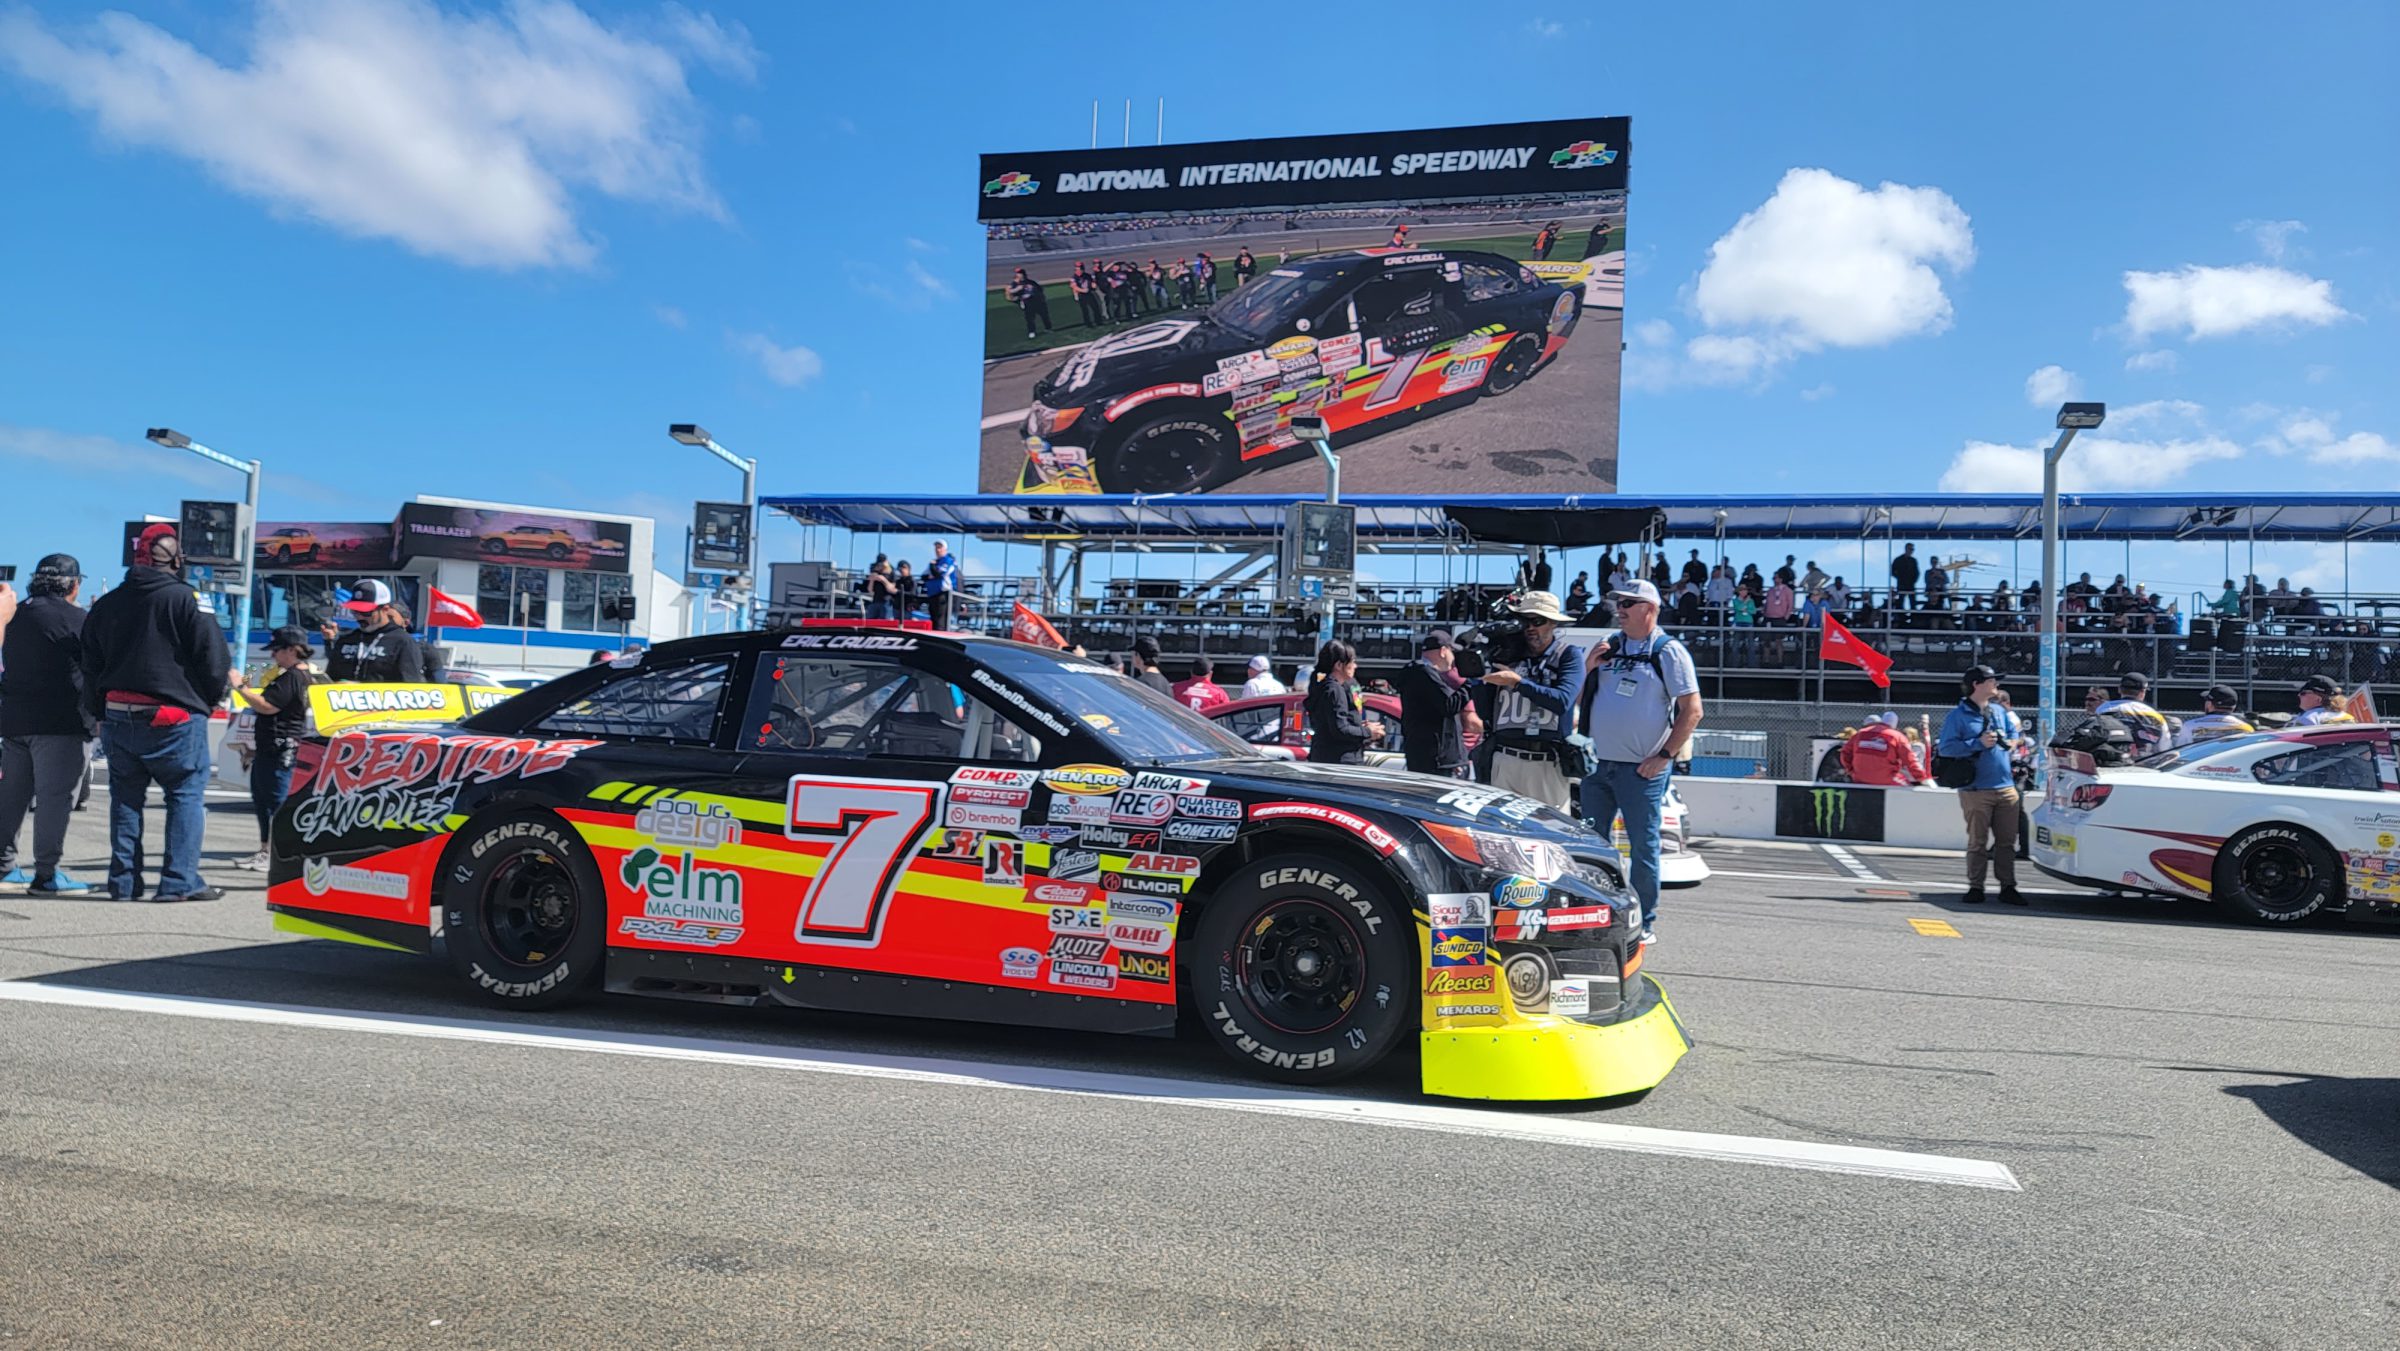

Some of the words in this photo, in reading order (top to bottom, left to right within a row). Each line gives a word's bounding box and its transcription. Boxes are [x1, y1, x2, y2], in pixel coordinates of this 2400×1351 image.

[1056, 168, 1164, 193] DAYTONA
[1179, 156, 1382, 187] INTERNATIONAL
[1391, 147, 1536, 176] SPEEDWAY
[1221, 356, 1249, 370] ARCA
[1451, 356, 1487, 376] elm
[1146, 421, 1223, 442] GENERAL
[410, 523, 472, 538] TRAILBLAZER
[780, 634, 831, 648] ERIC
[827, 635, 919, 650] CAUDELL
[326, 688, 446, 711] MENARDS
[971, 668, 1071, 738] #RachelDawnRuns
[957, 768, 1018, 782] COMP
[1039, 770, 1132, 788] MENARDS
[1136, 774, 1181, 791] ARCA
[956, 787, 1026, 801] PYROTECT
[1177, 796, 1239, 809] QUARTER
[656, 800, 731, 819] DOUG
[969, 811, 1017, 826] brembo
[1186, 805, 1240, 817] MASTER
[636, 809, 740, 848] design
[1082, 825, 1129, 849] Holley
[1167, 822, 1237, 838] COMETIC
[471, 822, 570, 859] GENERAL
[2232, 828, 2300, 858] GENERAL
[788, 777, 944, 945] 7
[1126, 853, 1198, 873] ARP
[647, 852, 740, 905] elm
[1122, 878, 1181, 894] ILMOR
[1259, 867, 1383, 935] GENERAL
[1501, 879, 1549, 907] Bounty
[647, 901, 741, 923] MACHINING
[1109, 898, 1167, 917] Intercomp
[1432, 904, 1462, 915] Sioux
[2257, 891, 2326, 922] GENERAL
[1432, 914, 1461, 926] Chief
[1113, 925, 1167, 943] DART
[1054, 936, 1105, 956] KLOTZ
[1436, 943, 1480, 954] SUNOCO
[1054, 961, 1106, 976] LINCOLN
[1119, 955, 1169, 977] UNOH
[469, 961, 570, 998] GENERAL
[1063, 974, 1109, 988] WELDERS
[1428, 967, 1493, 992] Reese's
[1550, 991, 1587, 1004] Richmond
[1436, 1006, 1499, 1017] MENARDS
[1212, 1001, 1336, 1069] GENERAL
